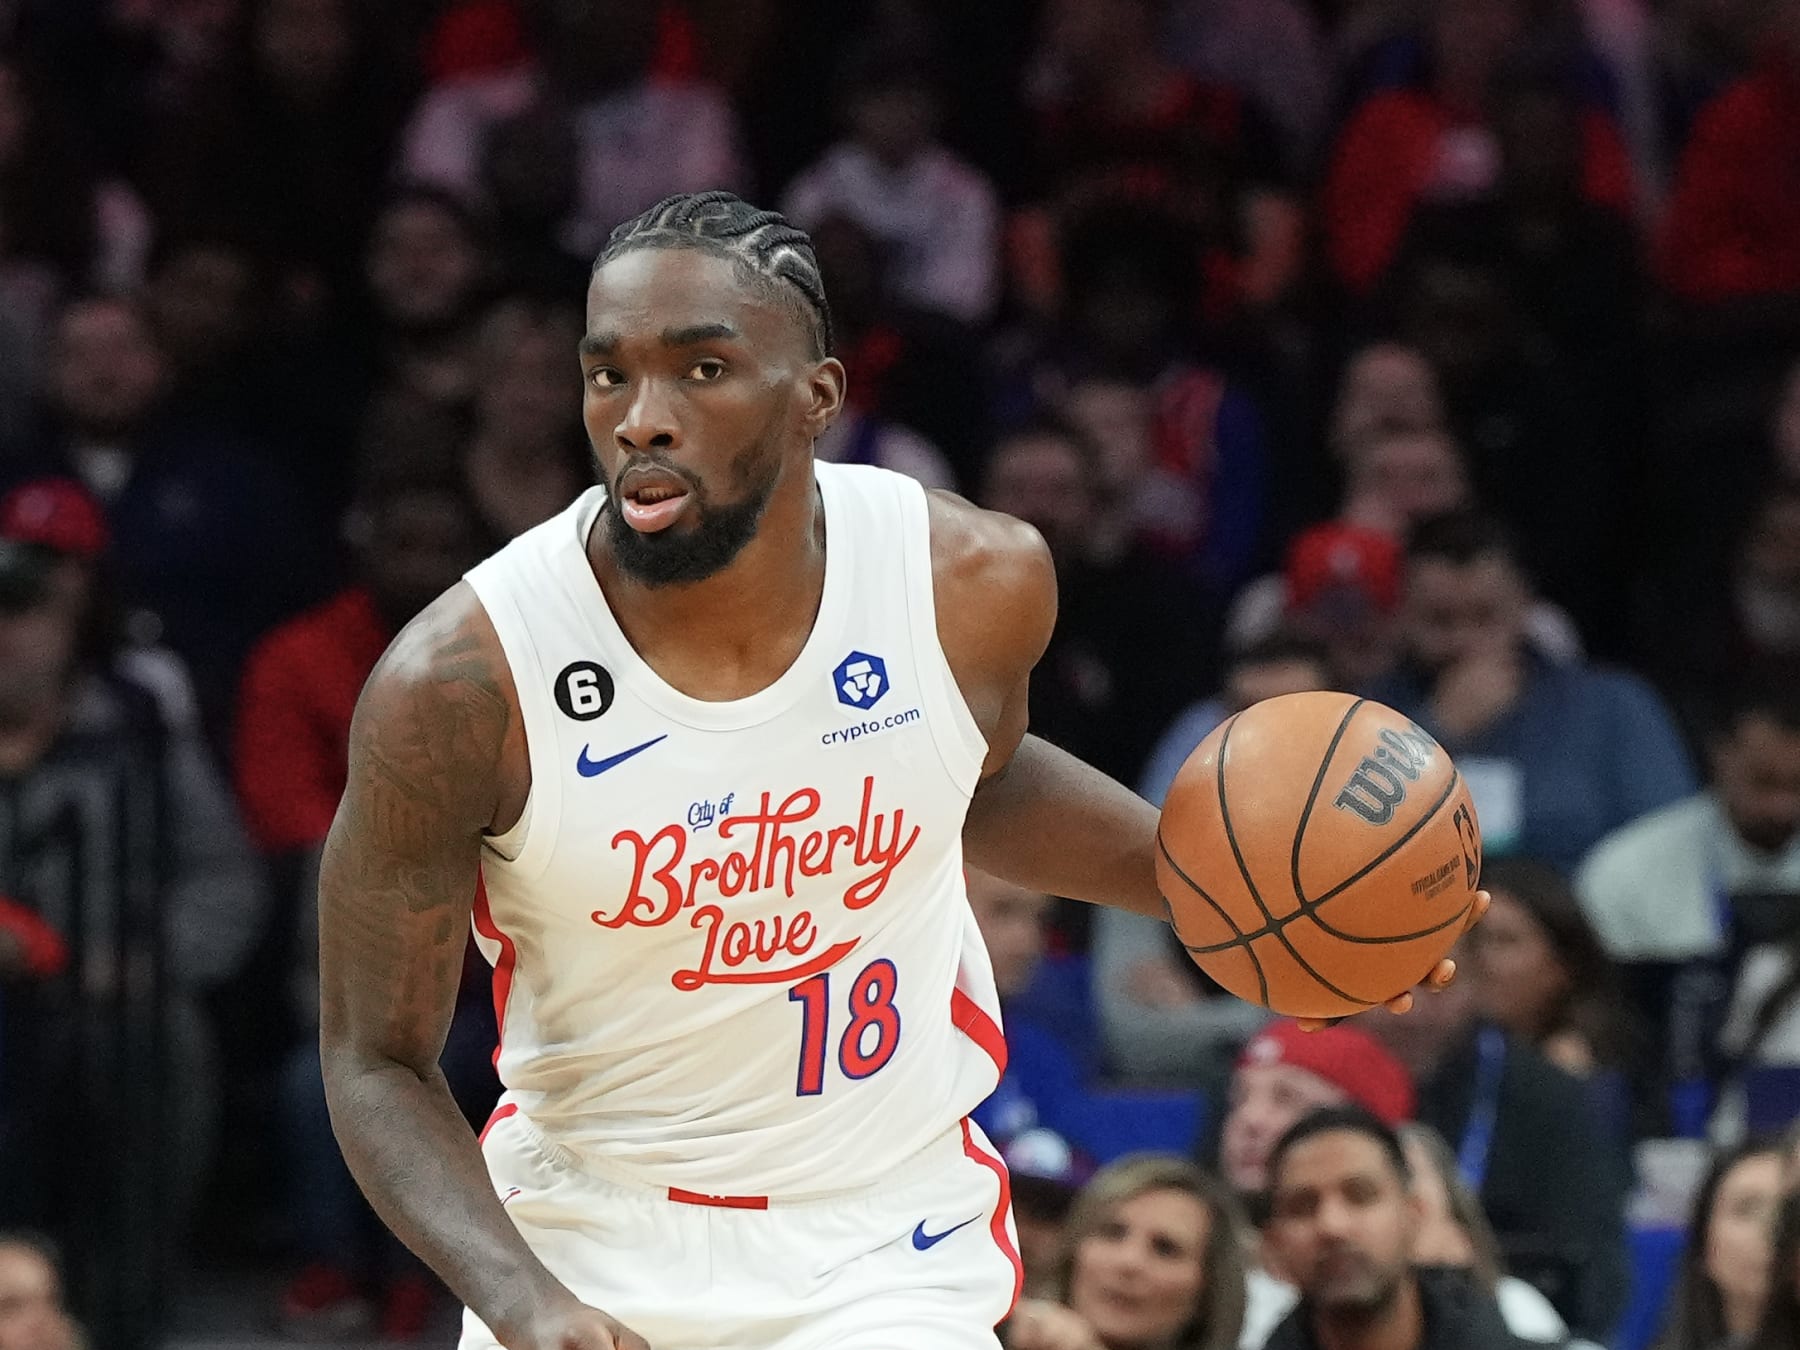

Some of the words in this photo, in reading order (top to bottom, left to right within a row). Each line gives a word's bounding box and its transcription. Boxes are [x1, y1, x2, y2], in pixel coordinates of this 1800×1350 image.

[567, 669, 602, 715] 6
[822, 709, 920, 745] crypto.com
[687, 800, 716, 833] City
[719, 792, 735, 815] of
[591, 776, 921, 929] Brotherly
[671, 904, 862, 991] Love
[788, 958, 902, 1097] 18
